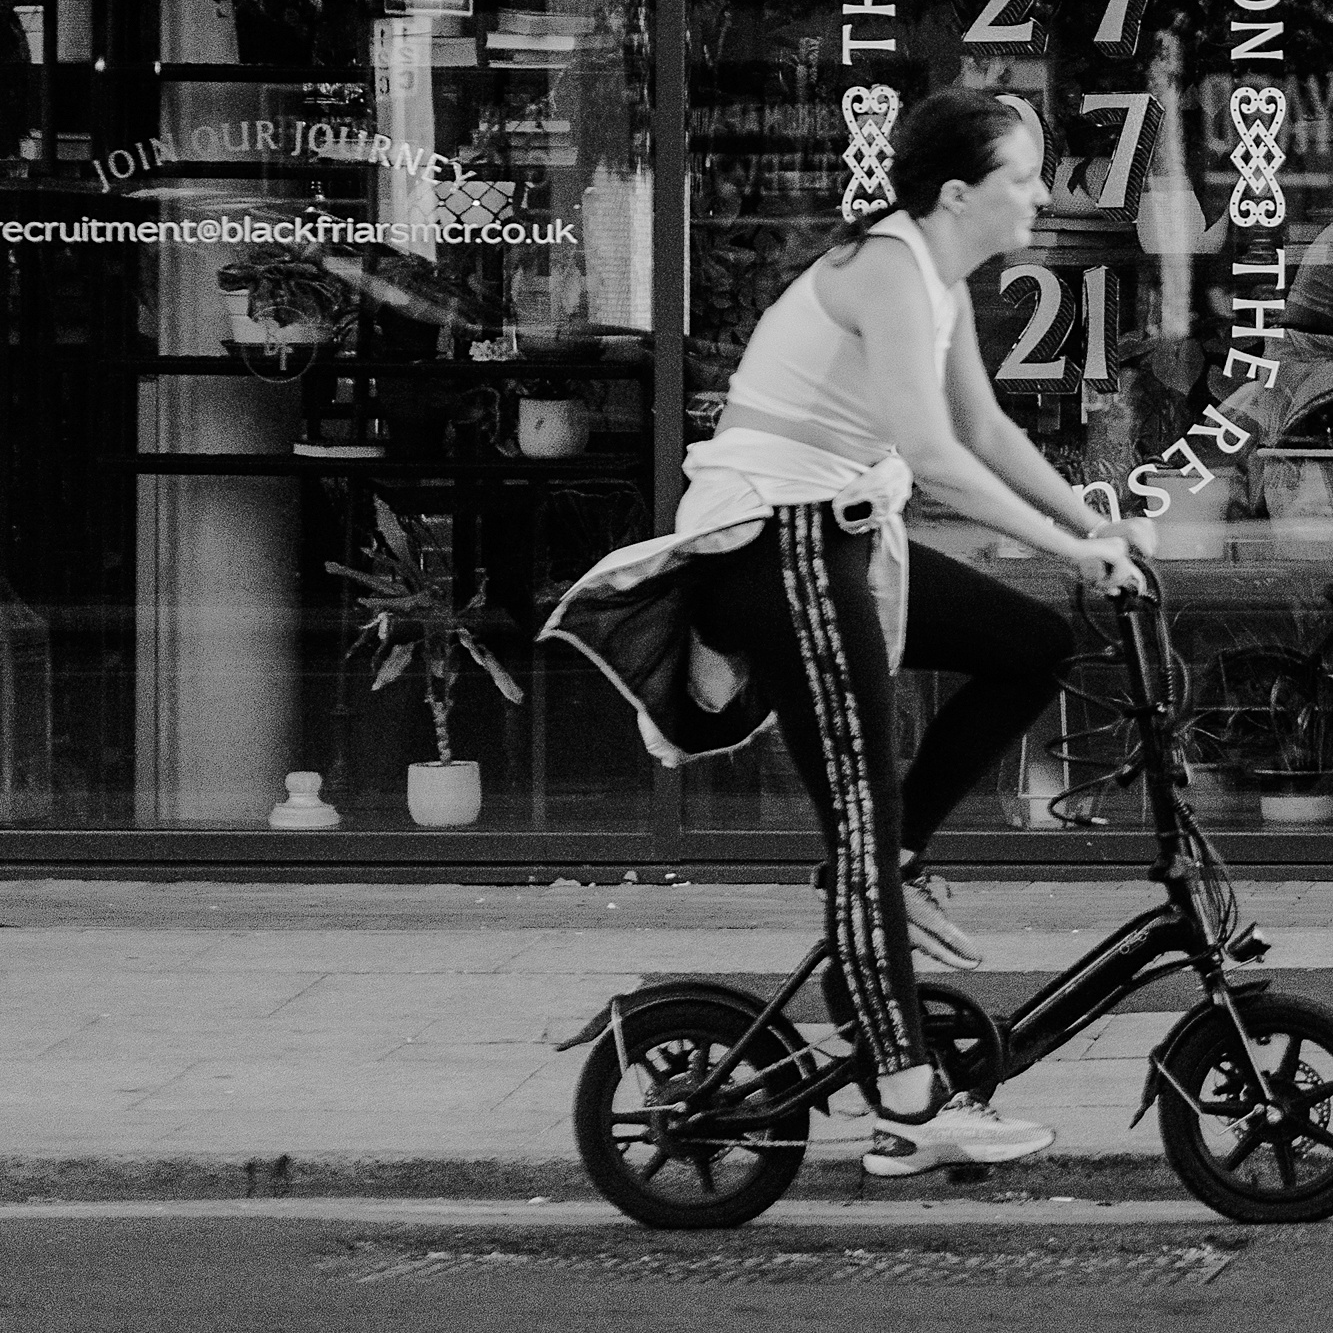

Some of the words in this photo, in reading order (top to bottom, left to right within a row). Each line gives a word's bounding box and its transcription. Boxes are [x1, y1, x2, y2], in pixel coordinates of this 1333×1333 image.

[92, 131, 179, 195] JOIN
[191, 119, 280, 156] OUR
[291, 119, 478, 195] JOURNEY
[0, 216, 578, 245] ecruitment@blackfriarsmcr.co.uk
[994, 263, 1120, 395] 21
[1222, 247, 1287, 390] THE
